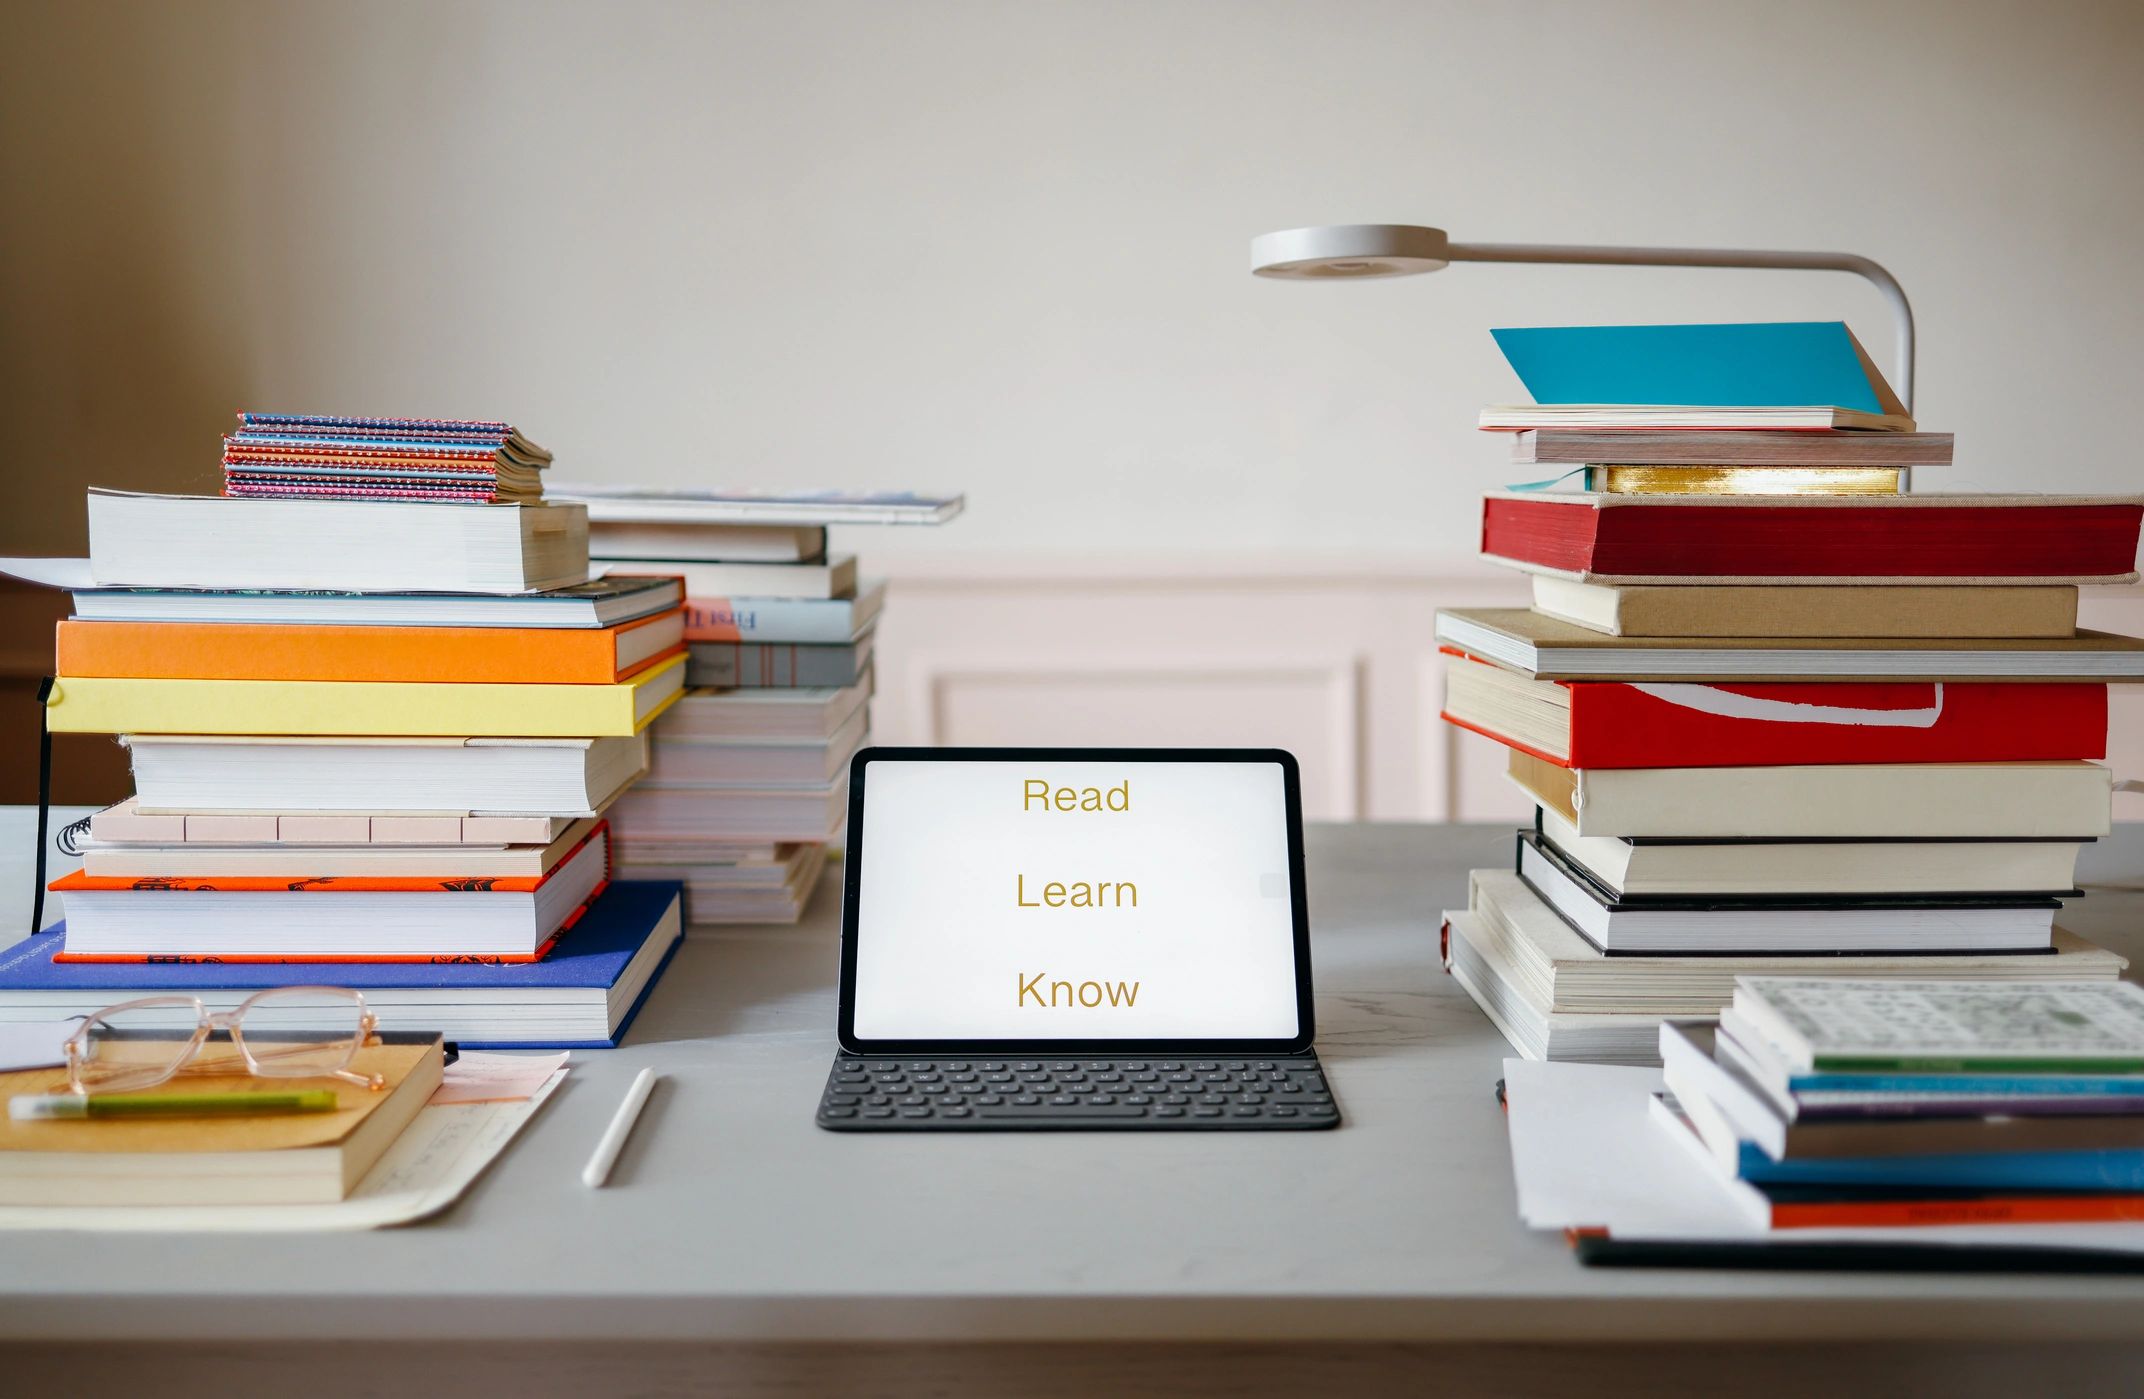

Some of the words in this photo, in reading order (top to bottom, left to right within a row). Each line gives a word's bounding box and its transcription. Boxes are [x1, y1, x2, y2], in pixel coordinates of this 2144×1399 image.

[711, 611, 756, 629] First
[1024, 780, 1128, 811] Read
[1019, 875, 1136, 907] Learn
[1019, 975, 1139, 1007] Know
